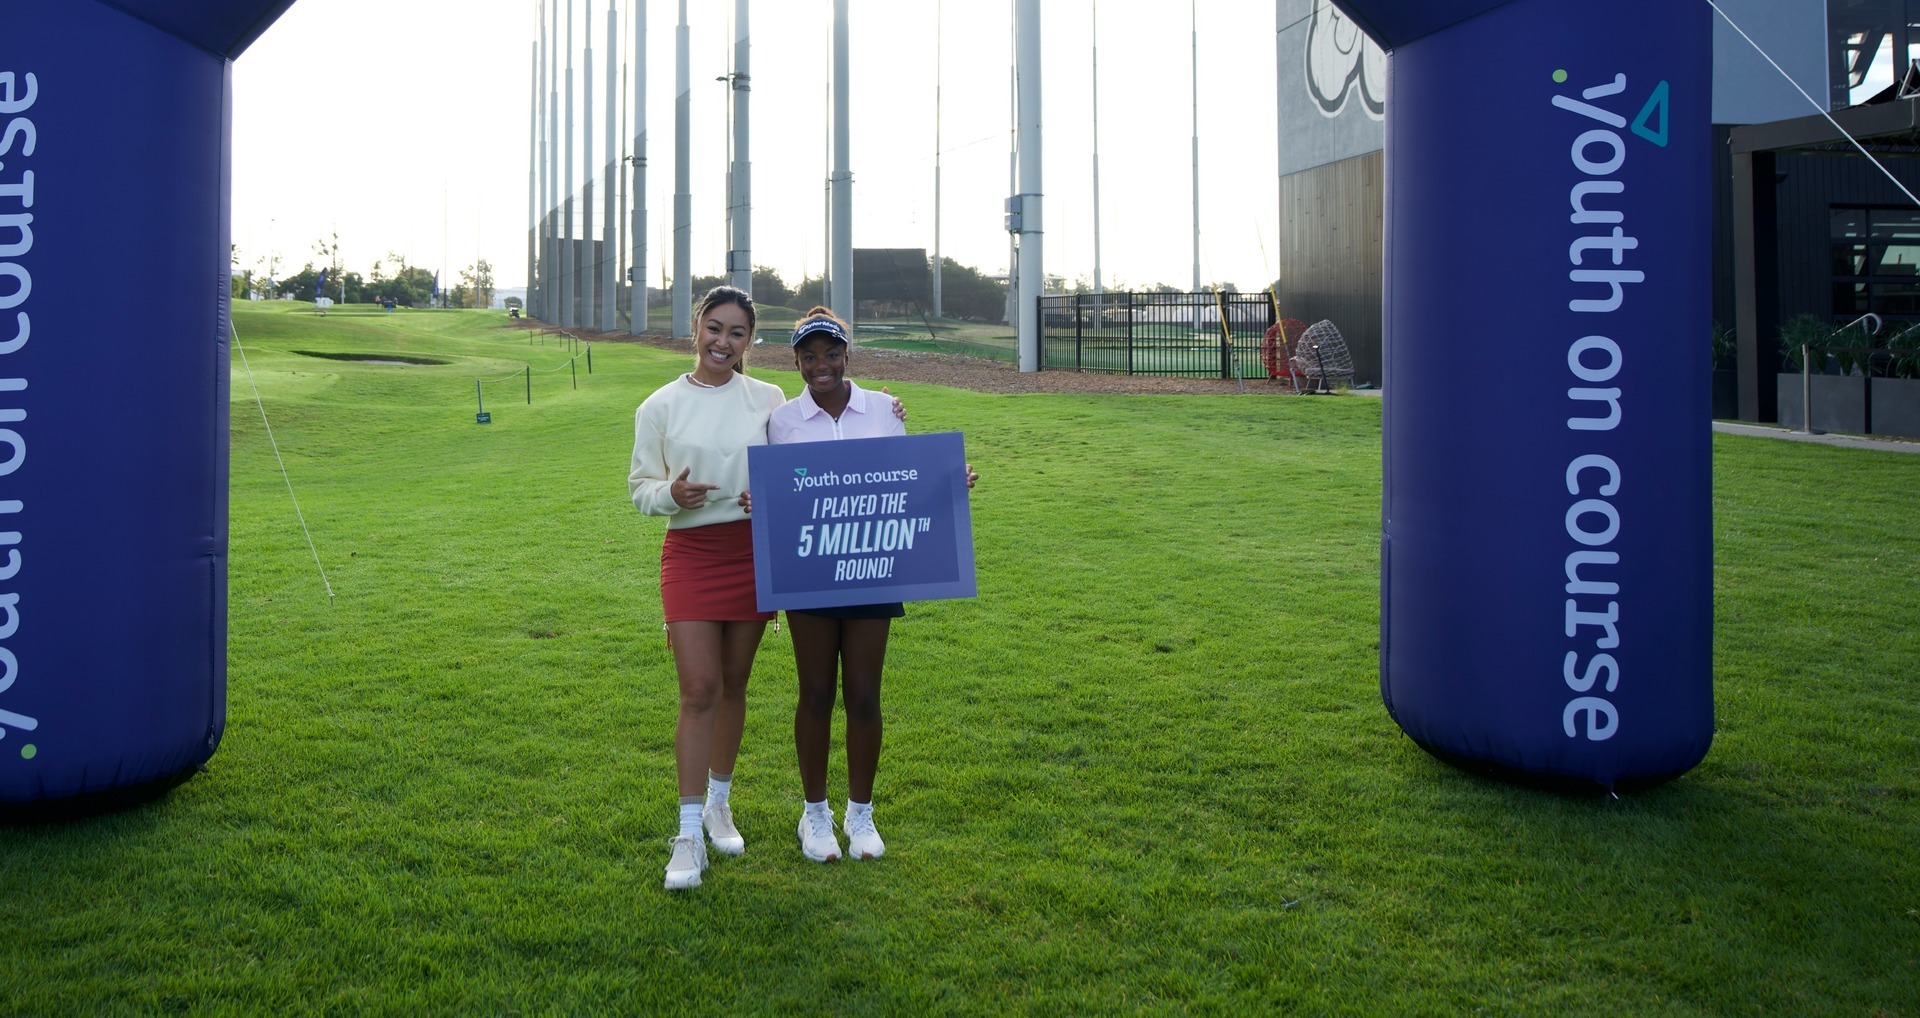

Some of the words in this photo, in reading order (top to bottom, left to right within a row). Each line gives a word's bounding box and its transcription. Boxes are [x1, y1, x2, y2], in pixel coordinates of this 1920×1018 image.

[1552, 69, 1644, 312] youth
[1567, 336, 1622, 431] on
[793, 470, 840, 491] youth
[843, 473, 862, 485] on
[865, 468, 918, 484] course
[812, 498, 819, 519] I
[821, 494, 878, 519] PLAYED
[881, 492, 908, 515] THE
[797, 525, 814, 557] 5
[834, 556, 895, 581] ROUND!
[1563, 454, 1620, 741] course
